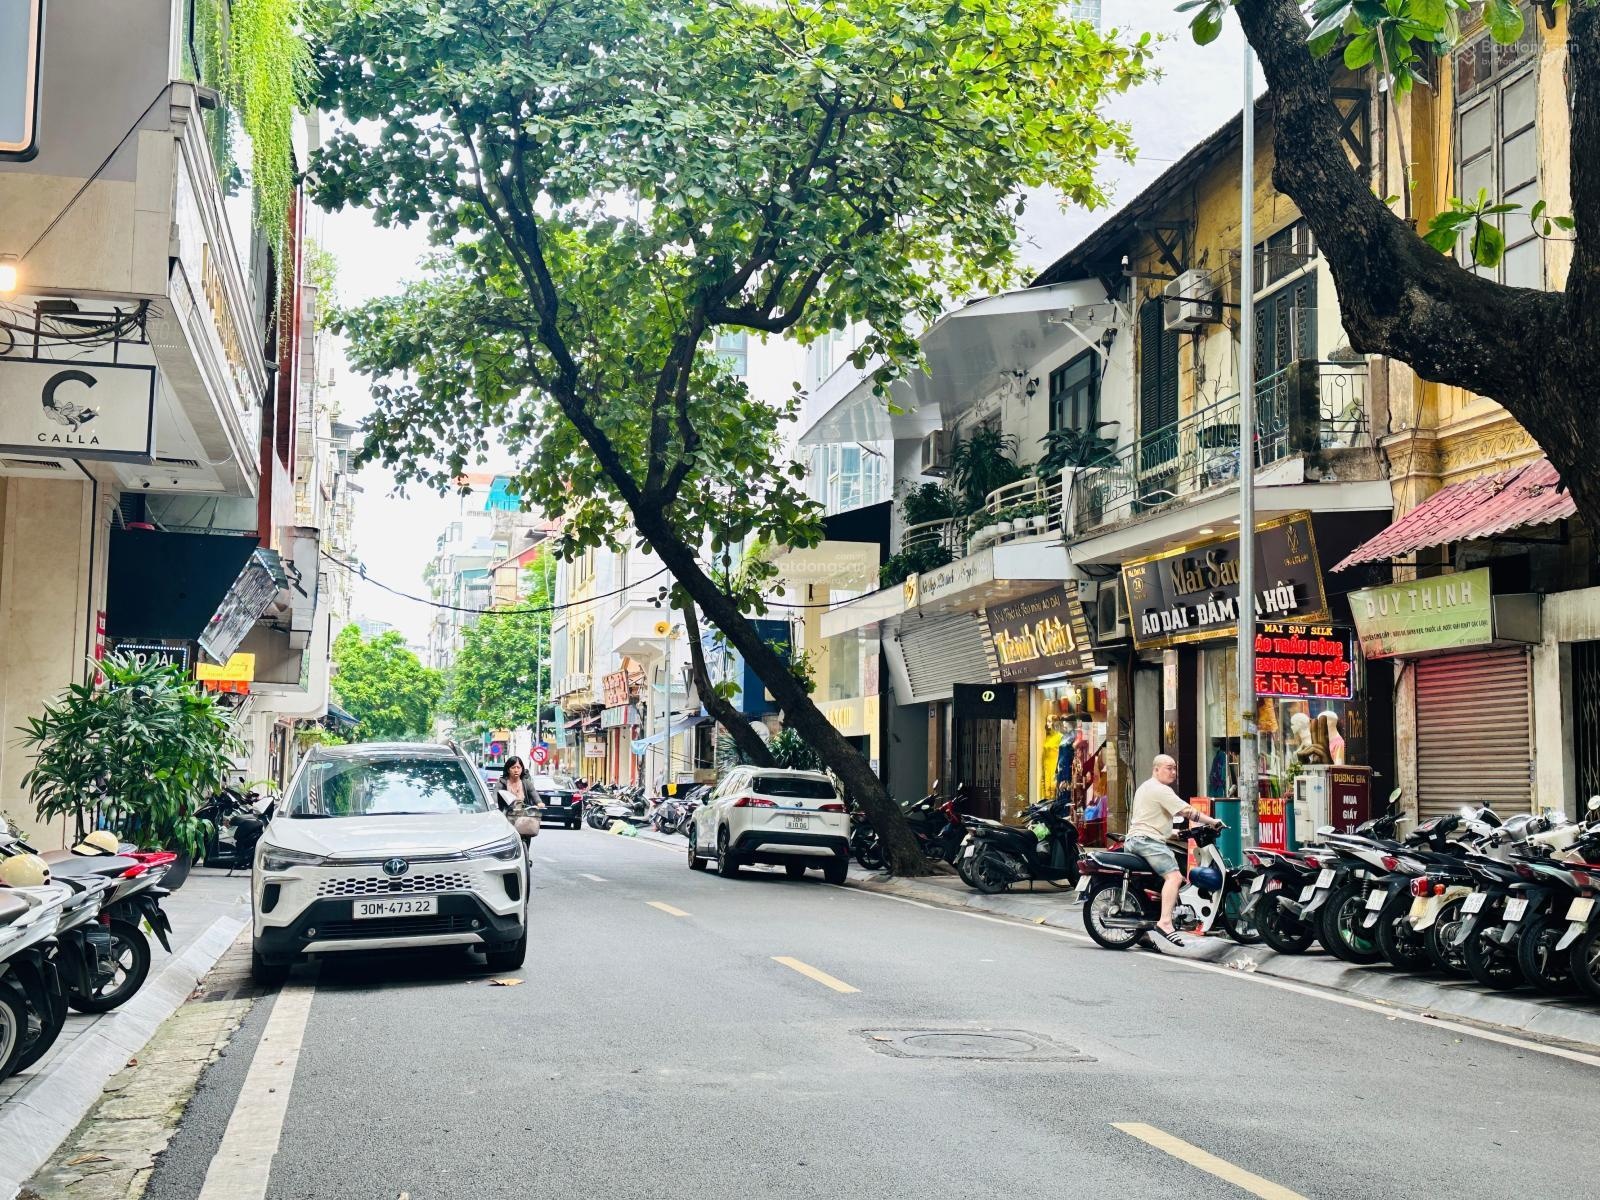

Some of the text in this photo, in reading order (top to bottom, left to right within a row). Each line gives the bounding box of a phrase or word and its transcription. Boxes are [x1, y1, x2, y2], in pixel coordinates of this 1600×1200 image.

[37, 432, 99, 444] CALLA
[1170, 559, 1204, 596] Mai
[1141, 609, 1161, 635] ÁO
[1160, 604, 1189, 631] DÀI
[1195, 592, 1236, 625] ĐẦM
[1263, 580, 1298, 616] HỘI
[1365, 581, 1472, 619] DUY THỊNH
[1264, 624, 1333, 636] MAI SAU SILK
[1255, 658, 1296, 674] ESTON
[1272, 678, 1299, 694] Nhà
[360, 900, 431, 915] 30M-473.22
